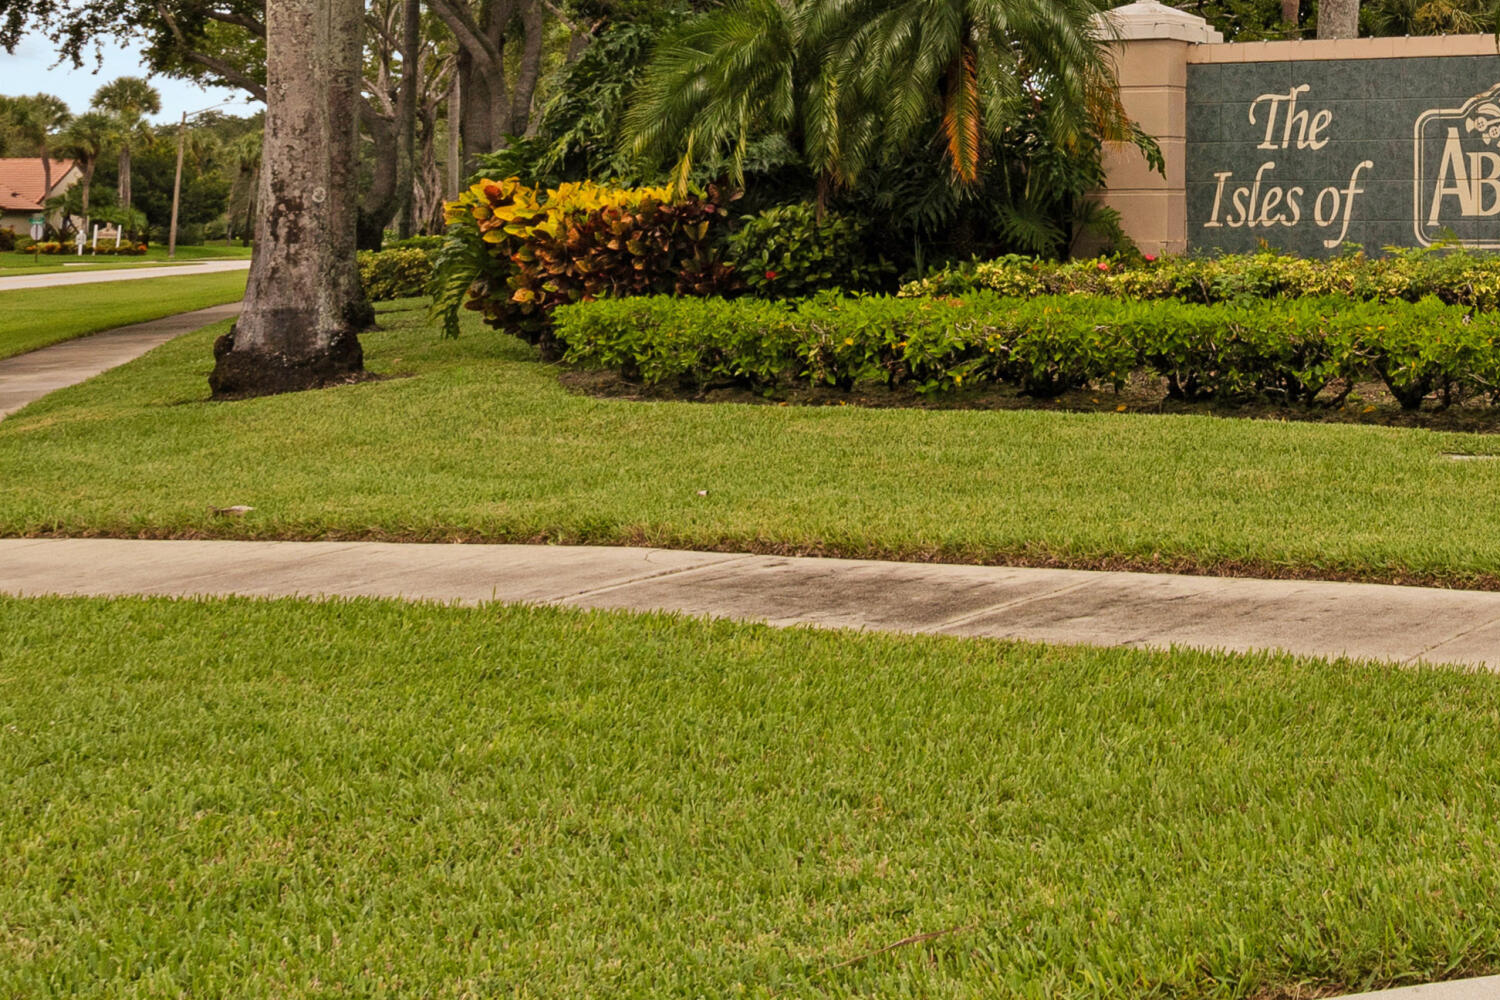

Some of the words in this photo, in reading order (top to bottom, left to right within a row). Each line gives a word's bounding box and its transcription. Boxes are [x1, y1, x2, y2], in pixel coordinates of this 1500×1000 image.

[1249, 83, 1333, 150] The
[1203, 161, 1304, 228] Isles
[1314, 159, 1374, 249] of
